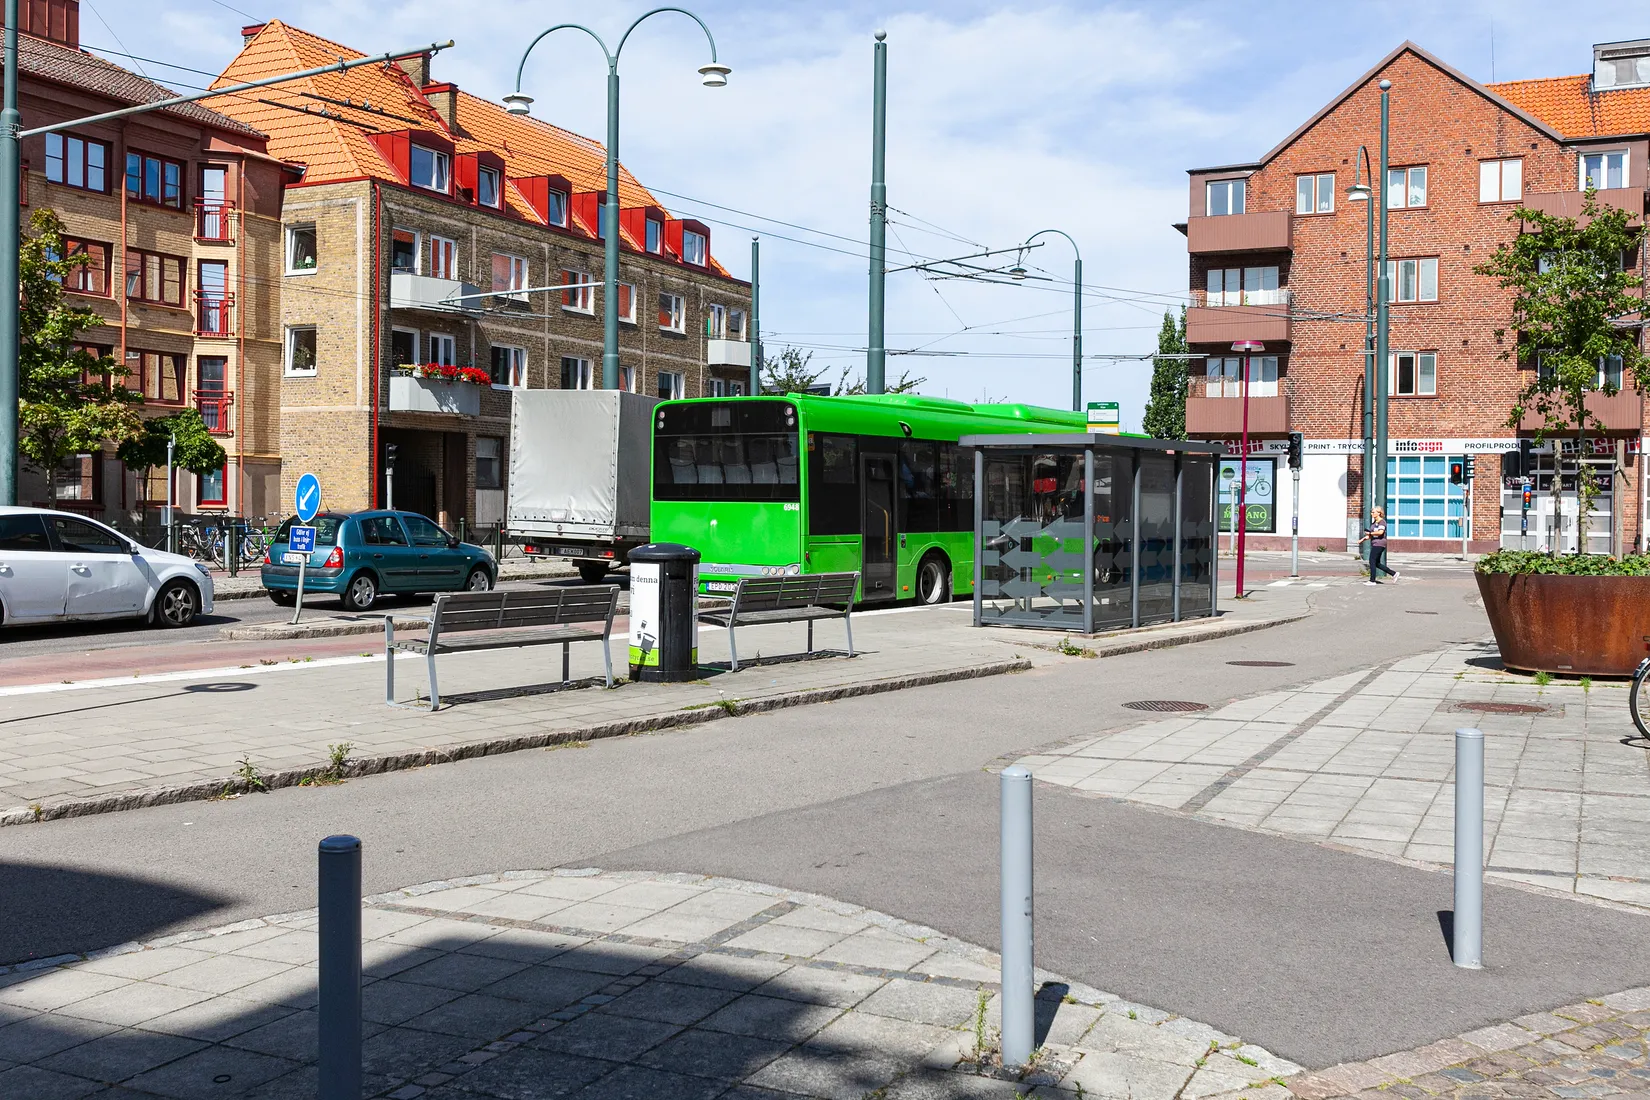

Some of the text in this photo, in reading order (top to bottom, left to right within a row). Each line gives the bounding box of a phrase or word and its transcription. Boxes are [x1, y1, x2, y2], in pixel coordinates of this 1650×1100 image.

[1395, 440, 1443, 453] infosign
[783, 503, 800, 511] 6948
[636, 575, 658, 584] denna
